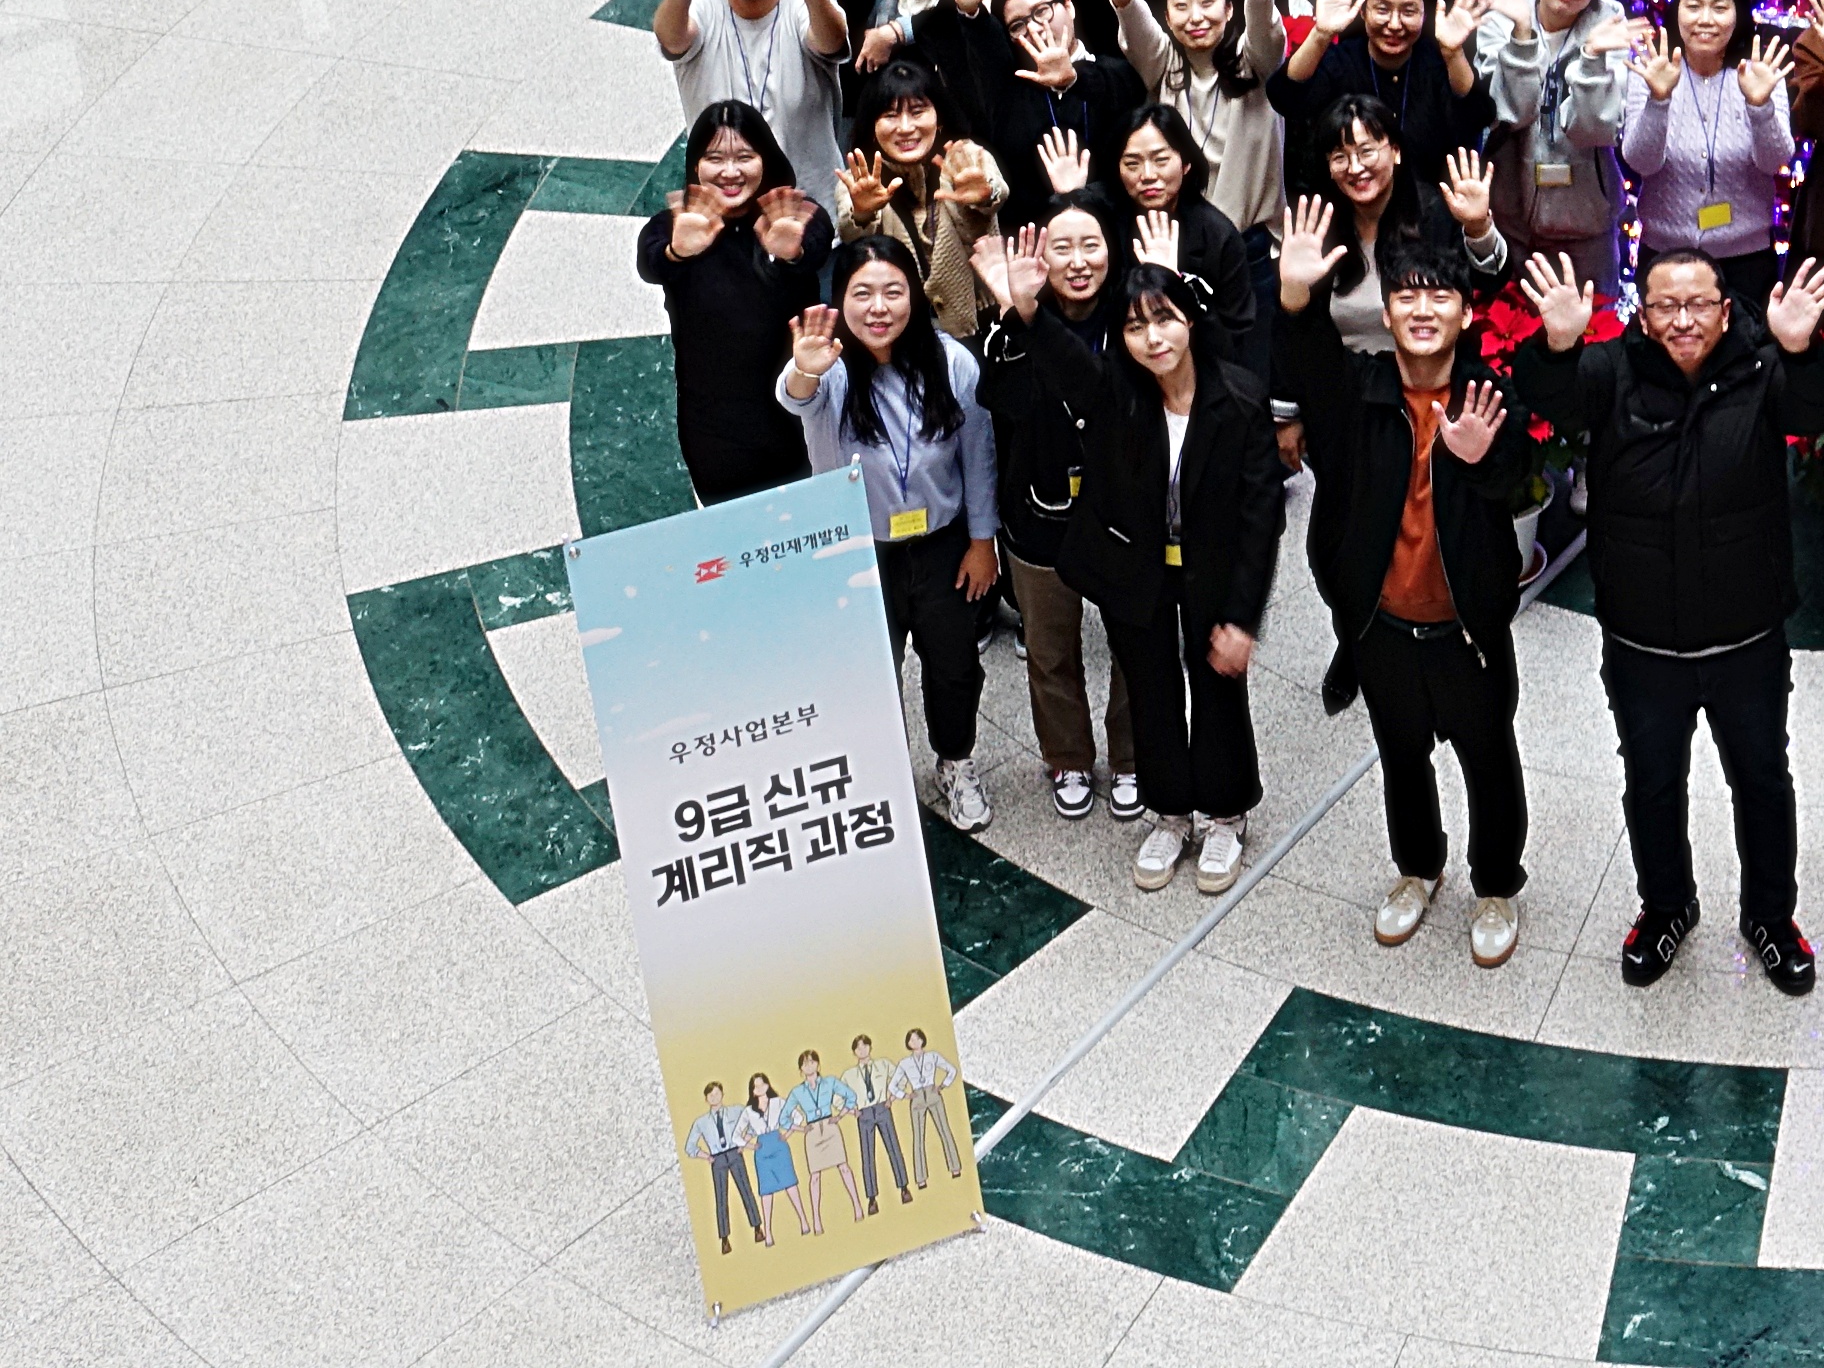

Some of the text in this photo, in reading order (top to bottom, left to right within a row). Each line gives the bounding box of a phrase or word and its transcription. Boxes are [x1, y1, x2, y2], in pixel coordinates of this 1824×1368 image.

[739, 524, 850, 568] 우정인재개발원
[669, 703, 820, 764] 우정사업본부
[674, 754, 853, 842] 9급 신규
[651, 800, 896, 908] 계리직 과정
